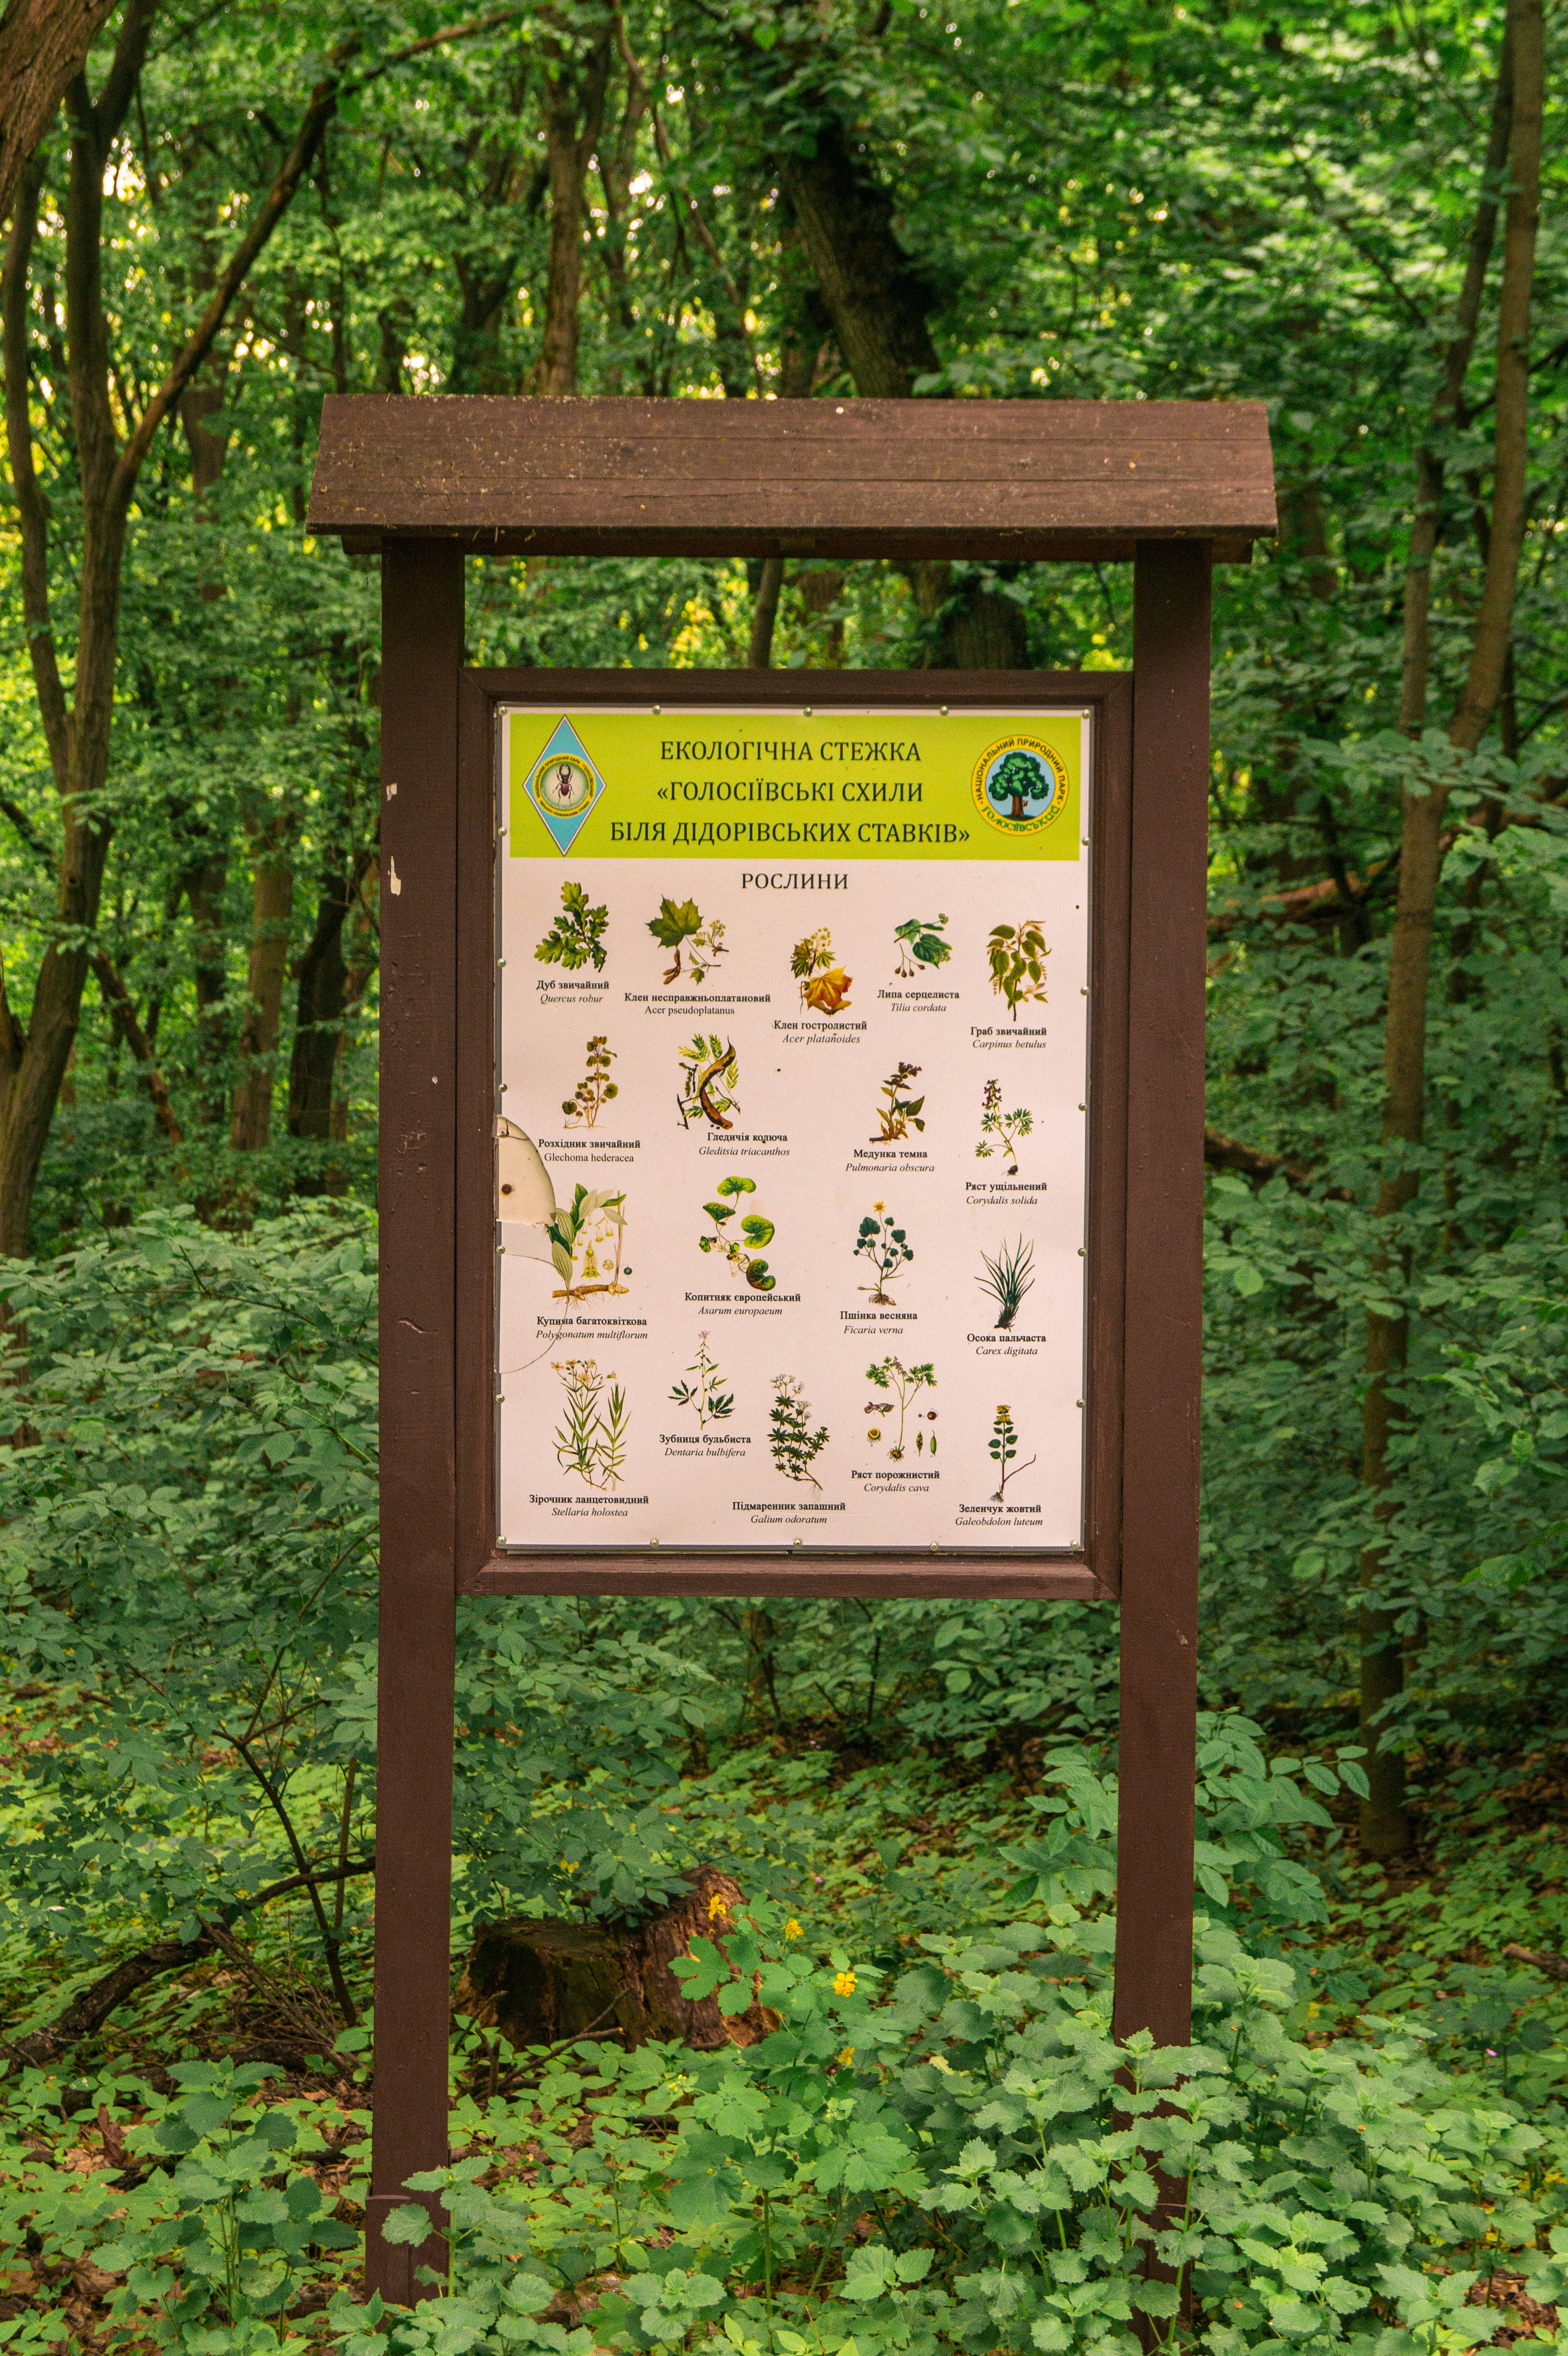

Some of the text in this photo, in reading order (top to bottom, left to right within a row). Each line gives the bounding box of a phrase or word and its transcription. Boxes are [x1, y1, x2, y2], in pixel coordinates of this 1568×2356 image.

[661, 741, 921, 761] ЕКОЛОГІЧНА СТЕЖКА
[975, 738, 1065, 802] НАЦІОНАЛЬНИЙ ПРИРОДНИЙ ПАРК
[657, 778, 922, 802] «ГОЛОСІЇВСЬКІ СХИЛИ
[611, 822, 970, 846] БІЛЯ ДІДОРІВСЬКИХ СТАВКІВ»
[742, 873, 847, 889] РОСЛИНИ
[536, 980, 609, 991] Дуб звичайний
[540, 994, 604, 1005] Quercus robur
[624, 992, 771, 1004] Клен несправжньоплатановий
[877, 989, 960, 1001] Липа серцелиста
[645, 1006, 735, 1016] Acer pseudoplatanus
[891, 1003, 947, 1012] Tilia cordata
[774, 1020, 867, 1032] Клен гостролистий
[971, 1026, 1047, 1038] Граб звичайний
[782, 1032, 860, 1045] Acer platanoides
[972, 1039, 1046, 1050] Carpinus betulus
[707, 1132, 788, 1144] Гледичія колюча
[538, 1139, 641, 1149] Розхідник звичайний
[699, 1146, 790, 1156] Gleditsia triacanthos
[854, 1149, 896, 1160] Медунка
[544, 1153, 634, 1162] Glechoma hederacea
[845, 1163, 935, 1172] Pulmonaria obscura
[965, 1181, 1047, 1193] Ряст ущільнений
[966, 1196, 1038, 1205] Corydalis solida
[685, 1292, 801, 1304] Копитняк європейський
[698, 1306, 783, 1317] Asarum europaeum
[840, 1311, 877, 1320] Пшінка
[537, 1316, 647, 1327] Купина багатоквіткова
[536, 1329, 648, 1341] Polygonatum multiflorum
[844, 1325, 876, 1334] Ficaria
[967, 1333, 996, 1342] Осока
[975, 1346, 1038, 1357] Carex digitata
[659, 1434, 752, 1445] Зубниця бульбиста
[664, 1447, 746, 1458] Dentaria bulbifera
[851, 1470, 940, 1481] Ряст порожнистий
[863, 1483, 906, 1494] Corydalis
[529, 1494, 649, 1505] Зірочник ланцетовидний
[551, 1507, 628, 1517] Stellaria holostea
[732, 1501, 846, 1512] Підмаренник запашний
[959, 1504, 1041, 1515] Зеленчук жовтий
[750, 1515, 827, 1523] Galium odoratum
[955, 1517, 1043, 1526] Galeobdolon luteum
